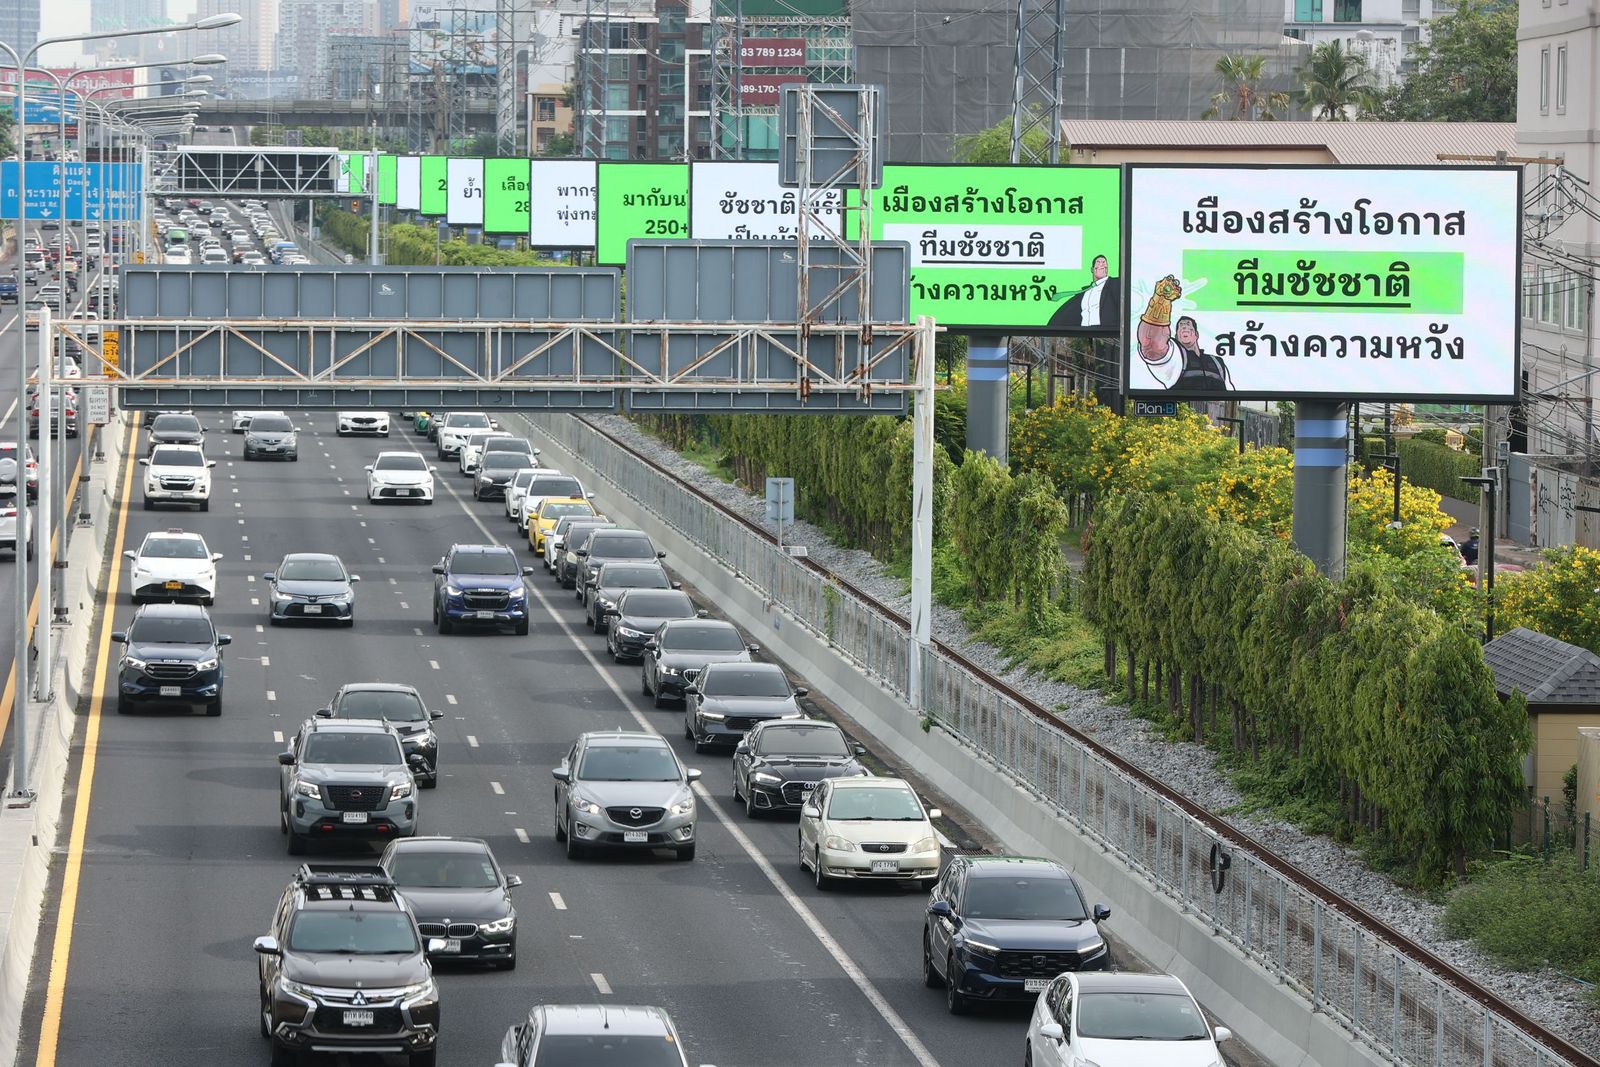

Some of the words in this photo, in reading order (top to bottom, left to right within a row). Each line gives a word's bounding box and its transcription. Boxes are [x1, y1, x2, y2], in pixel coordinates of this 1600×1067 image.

[735, 48, 754, 57] 83
[756, 48, 775, 57] 789
[777, 48, 803, 57] 1234
[883, 185, 1084, 214] เมืองสร้างโอกาส
[1183, 195, 1465, 236] เมืองสร้างโอกาส
[919, 229, 1045, 257] ทีมชัชชาติ
[1233, 257, 1411, 297] ทีมชัชชาติ
[1215, 320, 1464, 359] สร้างความหวัง
